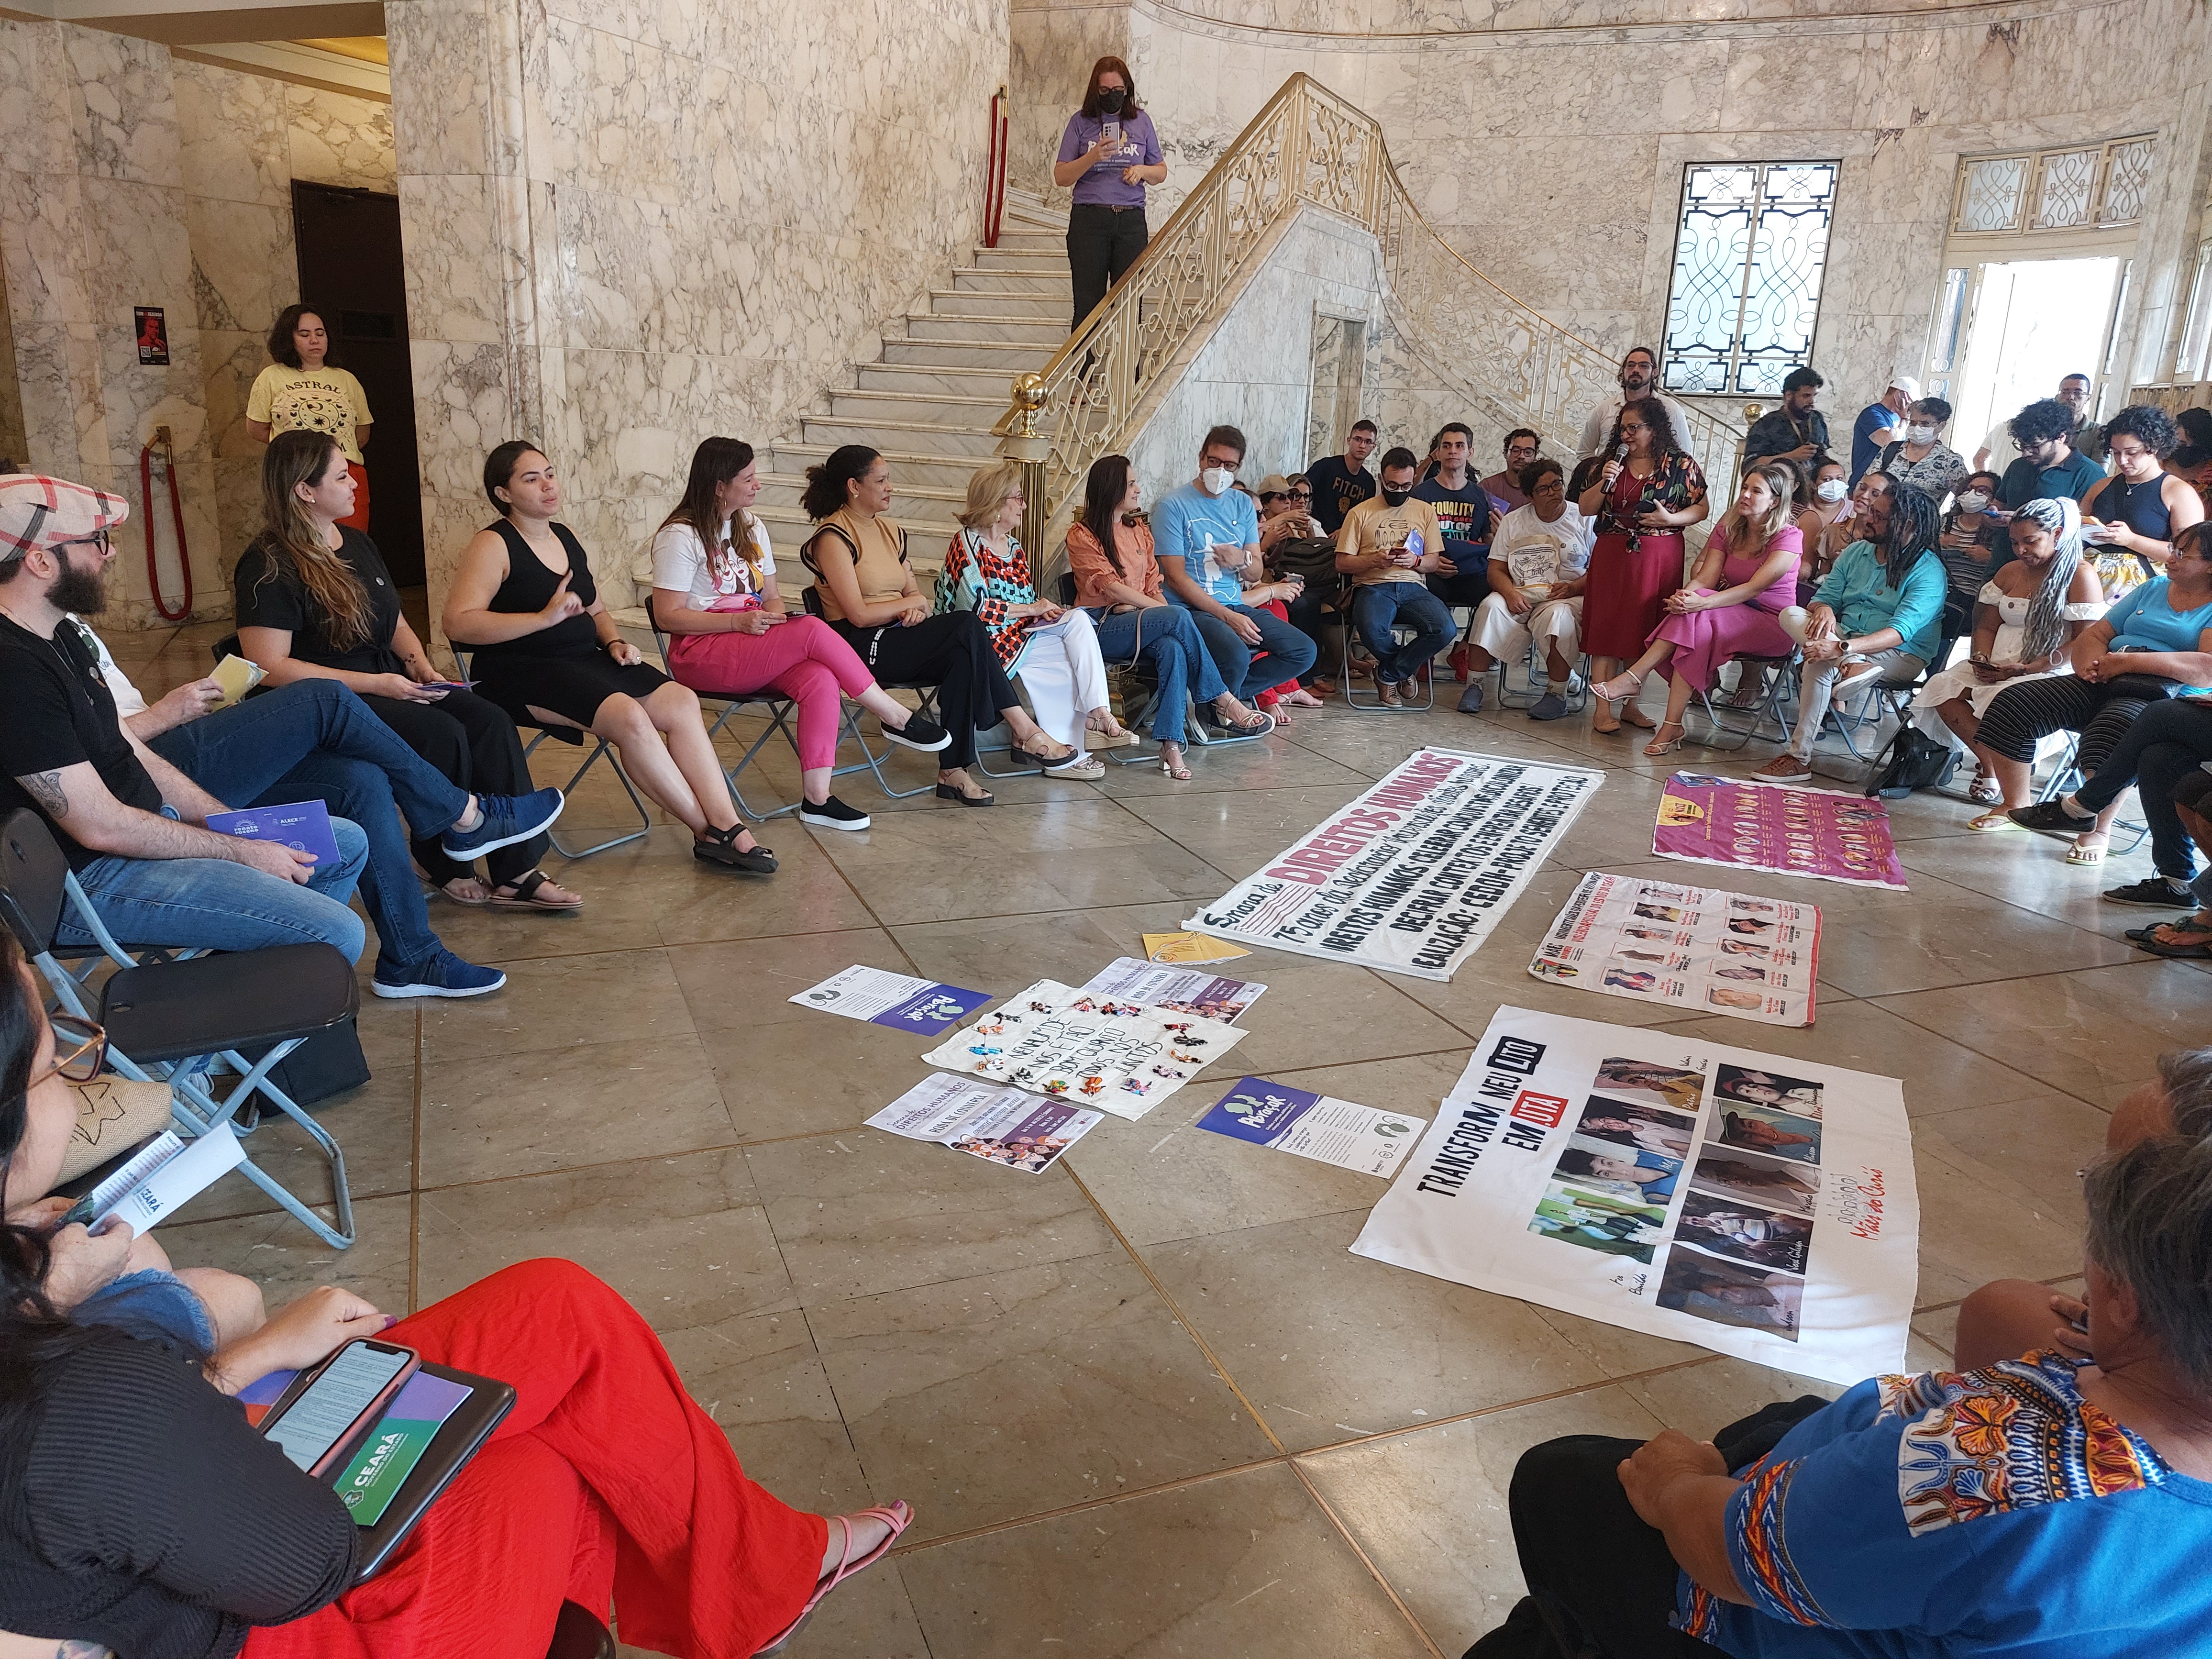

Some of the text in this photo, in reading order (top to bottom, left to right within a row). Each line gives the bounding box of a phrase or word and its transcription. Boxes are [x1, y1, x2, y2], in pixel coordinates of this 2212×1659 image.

[286, 381, 341, 394] ASTRAL
[1332, 476, 1365, 500] FITCH
[1456, 522, 1472, 531] OF
[1264, 753, 1463, 885] DIREITOS HUMANOS
[1389, 890, 1453, 932] DECIFRAR
[1429, 844, 1493, 890] CONTEXTOS
[1472, 809, 1525, 841] ENFRENTAR
[1252, 884, 1283, 894] de
[1316, 889, 1354, 904] da
[1296, 904, 1339, 929] anos
[1319, 908, 1384, 953] IREITOS
[1272, 926, 1313, 943] 75
[1409, 909, 1485, 969] EALIZAÇÃO:
[1123, 963, 1148, 981] HUMANOS
[1131, 991, 1148, 999] RODA
[1008, 1018, 1072, 1059] NENHUM DE
[1027, 1026, 1095, 1068] NÓS É TÃO
[1049, 1028, 1126, 1074] BOM QUANTO
[1075, 1035, 1139, 1078] TODOS NÓS
[1114, 1042, 1163, 1076] JUNTOS
[1478, 1072, 1522, 1100] MEU
[896, 1107, 931, 1129] DIREITOS
[928, 1082, 965, 1109] HUMANOS
[929, 1121, 953, 1133] RODA
[954, 1095, 988, 1115] CONVERSA
[1501, 1121, 1546, 1151] EM
[1865, 1196, 1884, 1213] do
[1849, 1210, 1882, 1242] Mães
[390, 1433, 404, 1453] ESTADO
[354, 1433, 400, 1486] CEARÁ
